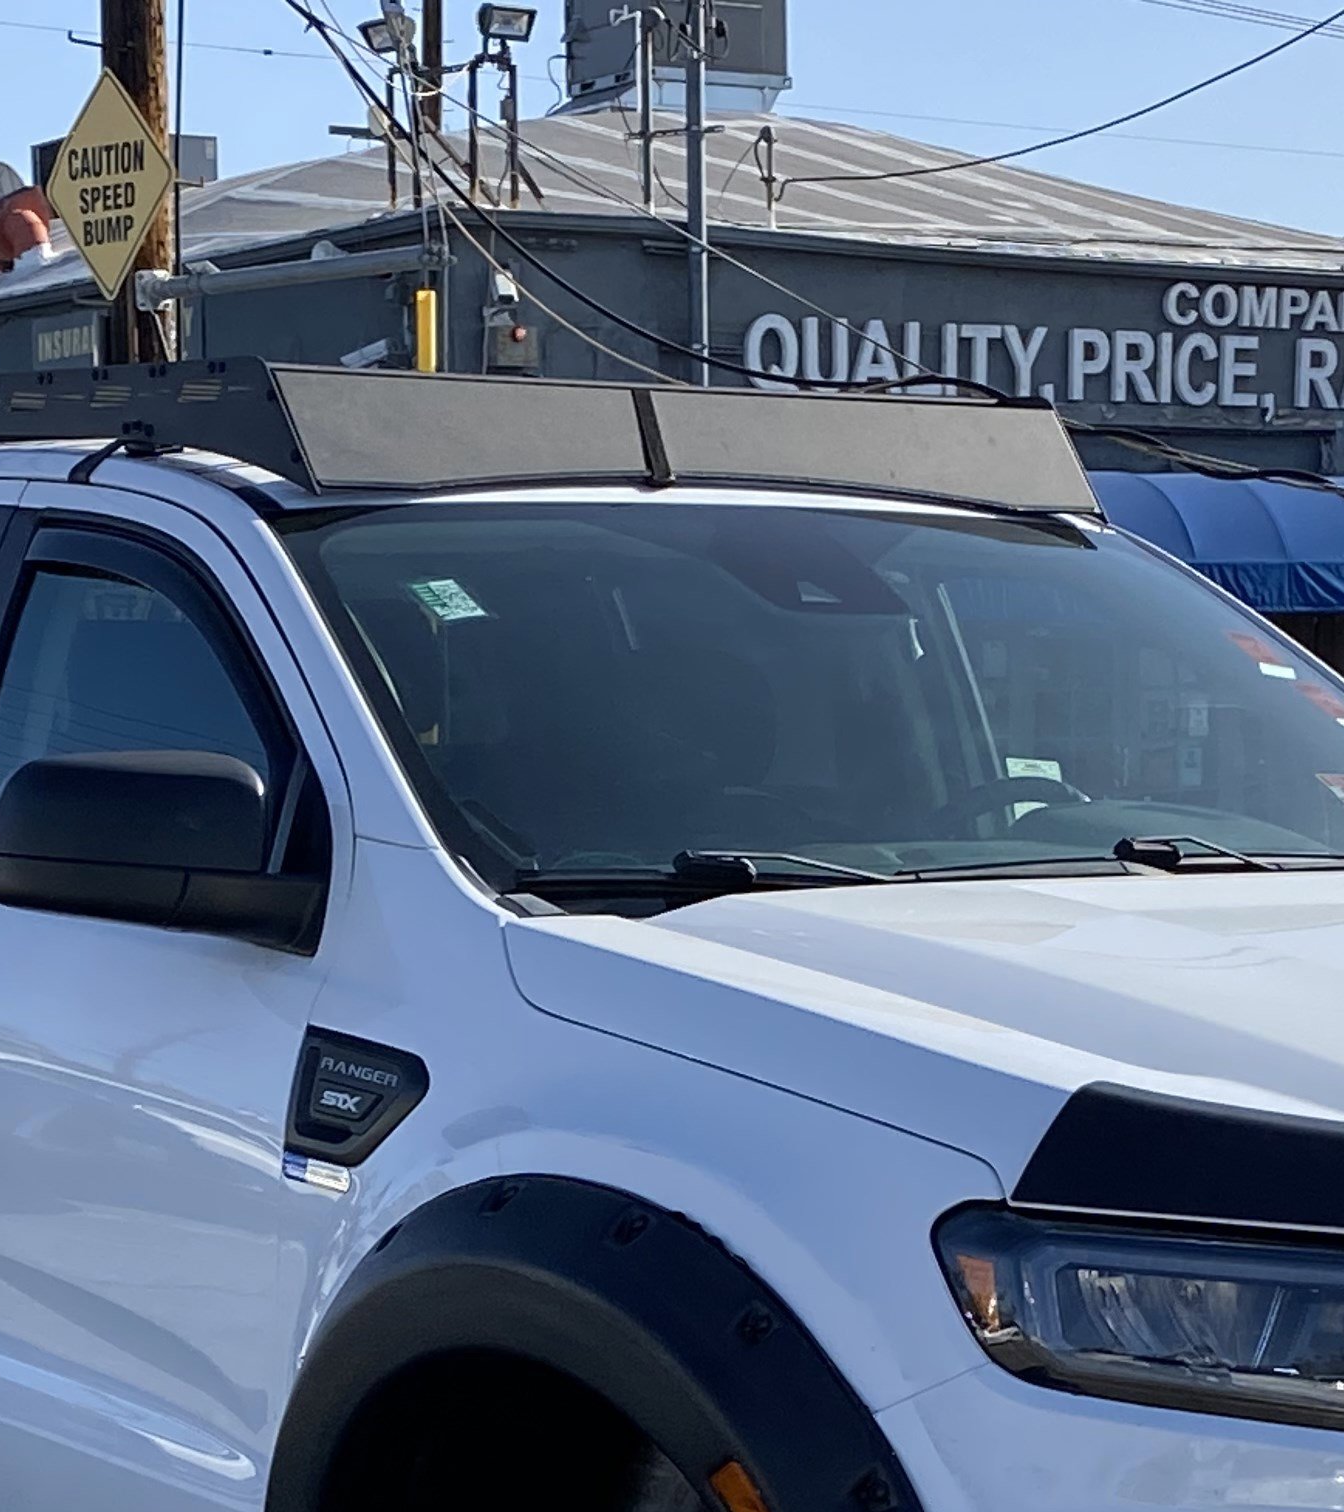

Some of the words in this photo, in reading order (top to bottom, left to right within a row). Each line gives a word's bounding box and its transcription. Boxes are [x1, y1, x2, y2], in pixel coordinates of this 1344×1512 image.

[67, 140, 144, 181] CAUTION
[79, 182, 135, 214] SPEED
[83, 215, 134, 247] BUMP
[1067, 327, 1276, 423] PRICE,
[320, 1056, 400, 1088] RANGER
[320, 1090, 363, 1114] STX
